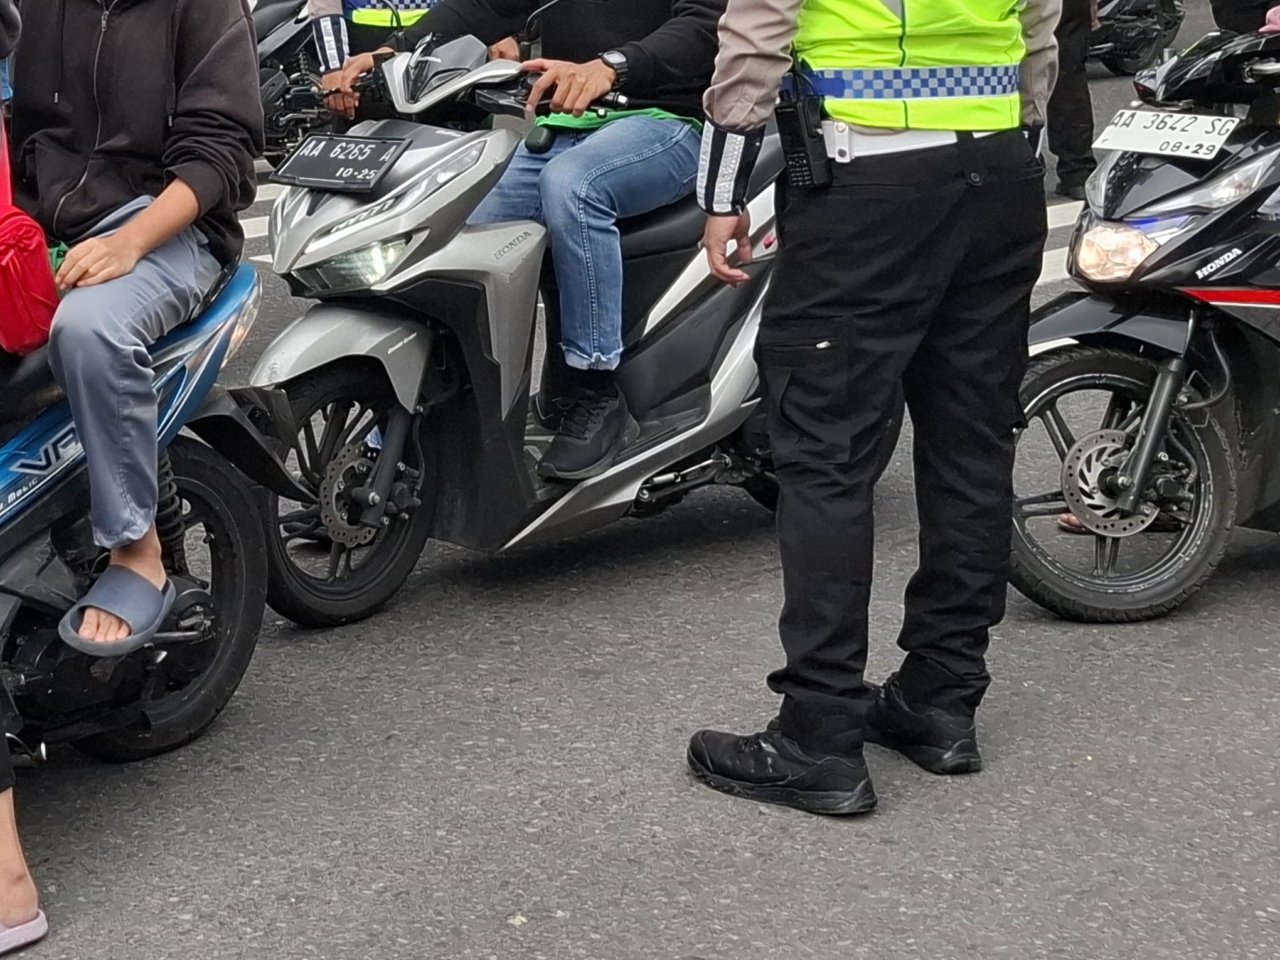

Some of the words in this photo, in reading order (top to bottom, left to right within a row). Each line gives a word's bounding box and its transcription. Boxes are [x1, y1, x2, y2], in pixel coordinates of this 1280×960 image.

[1111, 111, 1138, 129] AA
[1142, 113, 1199, 133] 3642
[1204, 118, 1236, 136] SG
[299, 140, 327, 157] AA
[329, 142, 376, 161] 6265
[379, 145, 398, 162] A
[493, 230, 532, 260] HONDA
[1195, 247, 1243, 280] HONDA
